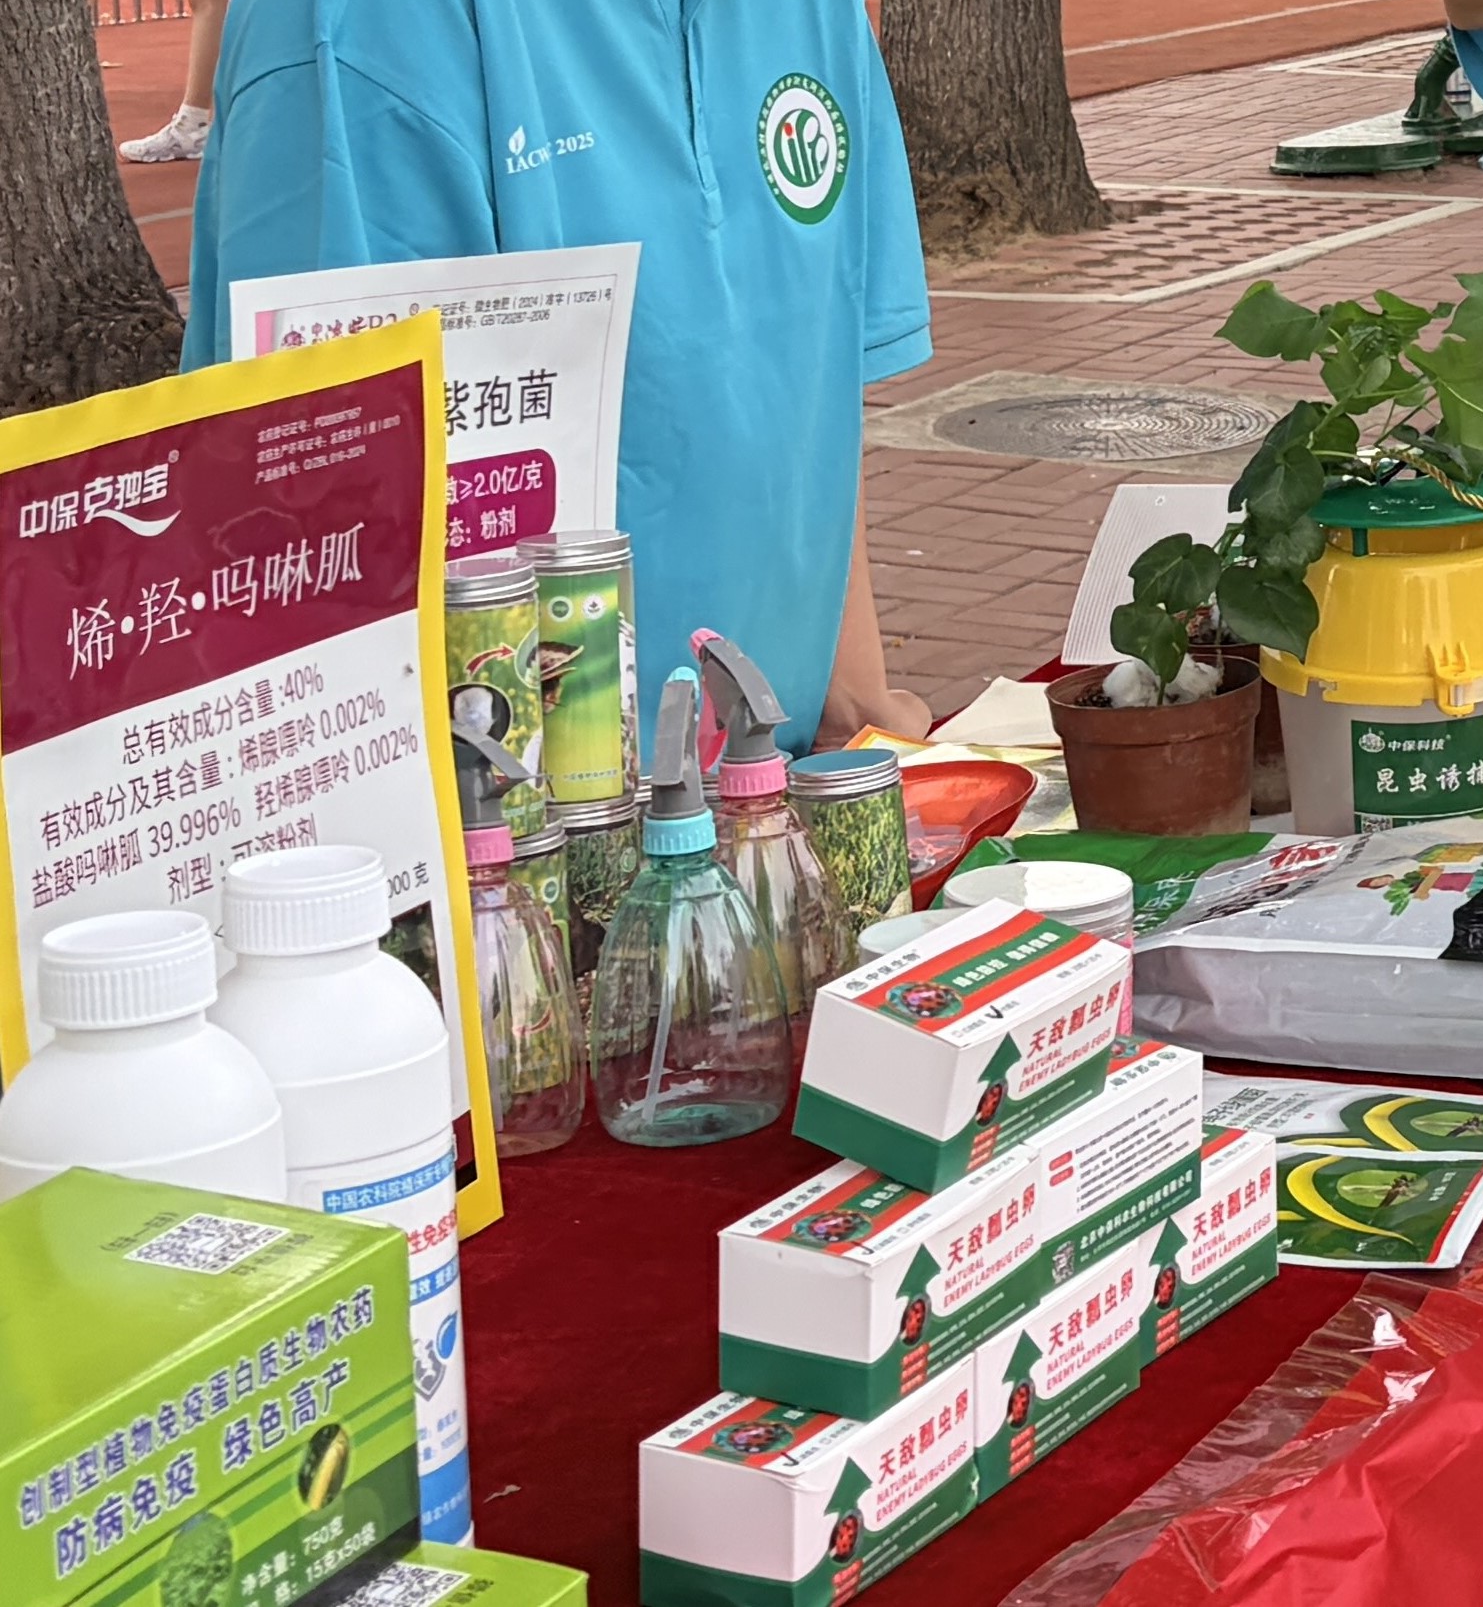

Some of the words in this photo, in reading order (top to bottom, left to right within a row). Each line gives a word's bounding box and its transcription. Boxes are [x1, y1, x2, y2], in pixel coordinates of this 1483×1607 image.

[556, 132, 595, 156] 2025
[19, 462, 171, 538] 中保克独宝
[320, 688, 386, 741] 0.002%
[1388, 738, 1446, 752] 中保科技
[32, 827, 141, 910] 盐酸吗啉胍
[148, 797, 241, 859] 39.996%
[355, 723, 419, 777] 0.002%
[1023, 1047, 1062, 1078] NATURAL
[948, 1182, 1036, 1271] 天敌瓢虫卵
[1193, 1166, 1272, 1242] 天敌瓢虫卵
[944, 1255, 986, 1292] NATURAL
[1191, 1230, 1227, 1262] NATURAL
[1048, 1268, 1134, 1355] 天敌瓢虫卵
[1047, 1340, 1086, 1374] NATURAL
[17, 1284, 375, 1531] 创制型植物免疫蛋白质生物农药
[878, 1388, 970, 1485] 天敌瓢虫卵
[54, 1449, 198, 1581] 防病免疫
[221, 1357, 352, 1476] 绿色高产
[876, 1467, 918, 1505] NATURAL
